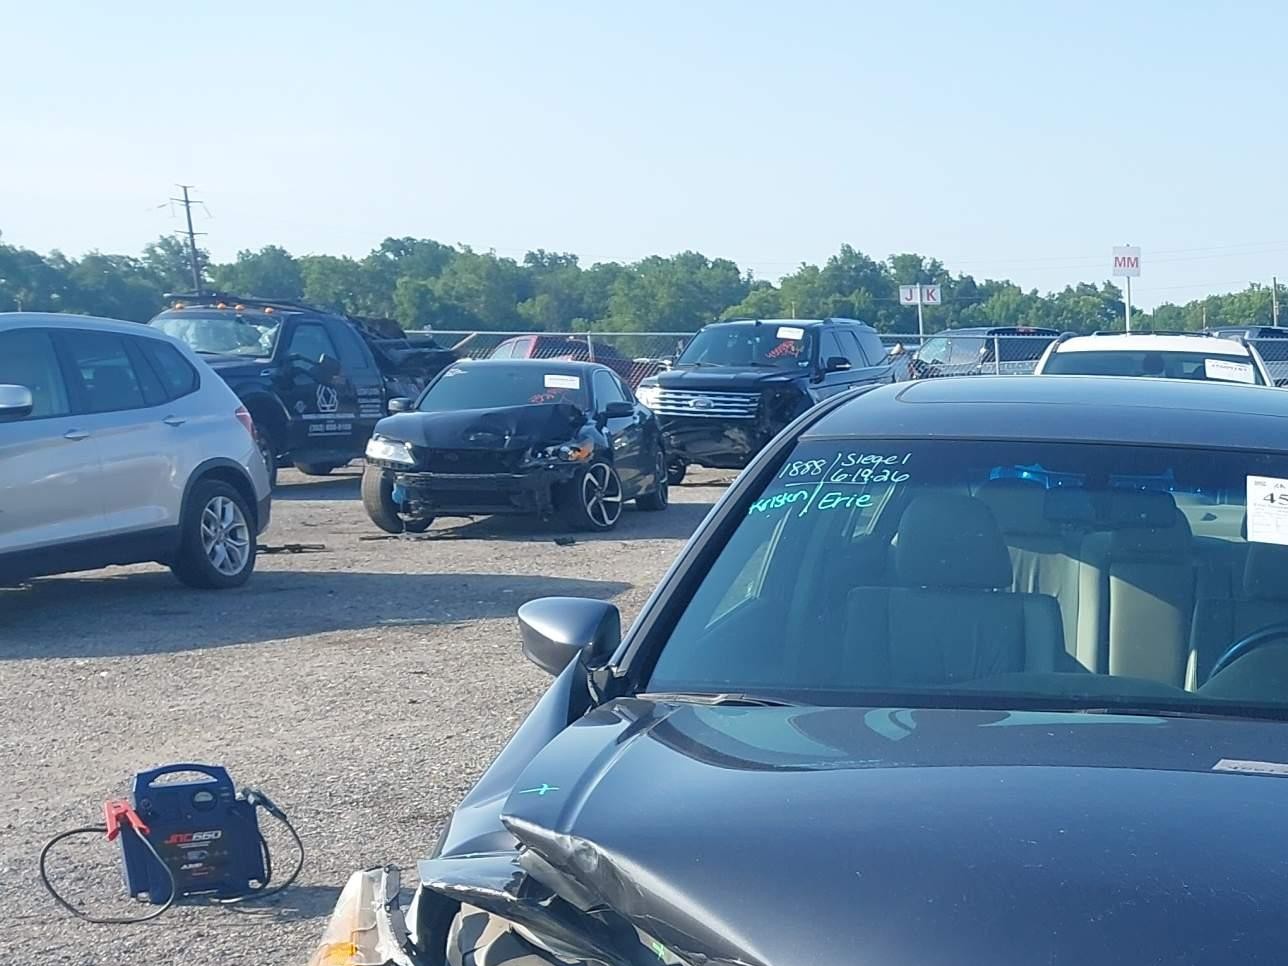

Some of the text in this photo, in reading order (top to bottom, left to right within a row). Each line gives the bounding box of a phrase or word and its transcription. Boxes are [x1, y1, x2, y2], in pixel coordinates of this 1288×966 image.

[1114, 256, 1139, 268] MM
[904, 288, 937, 302] J K
[779, 459, 826, 479] 1888
[818, 492, 873, 510] Erie
